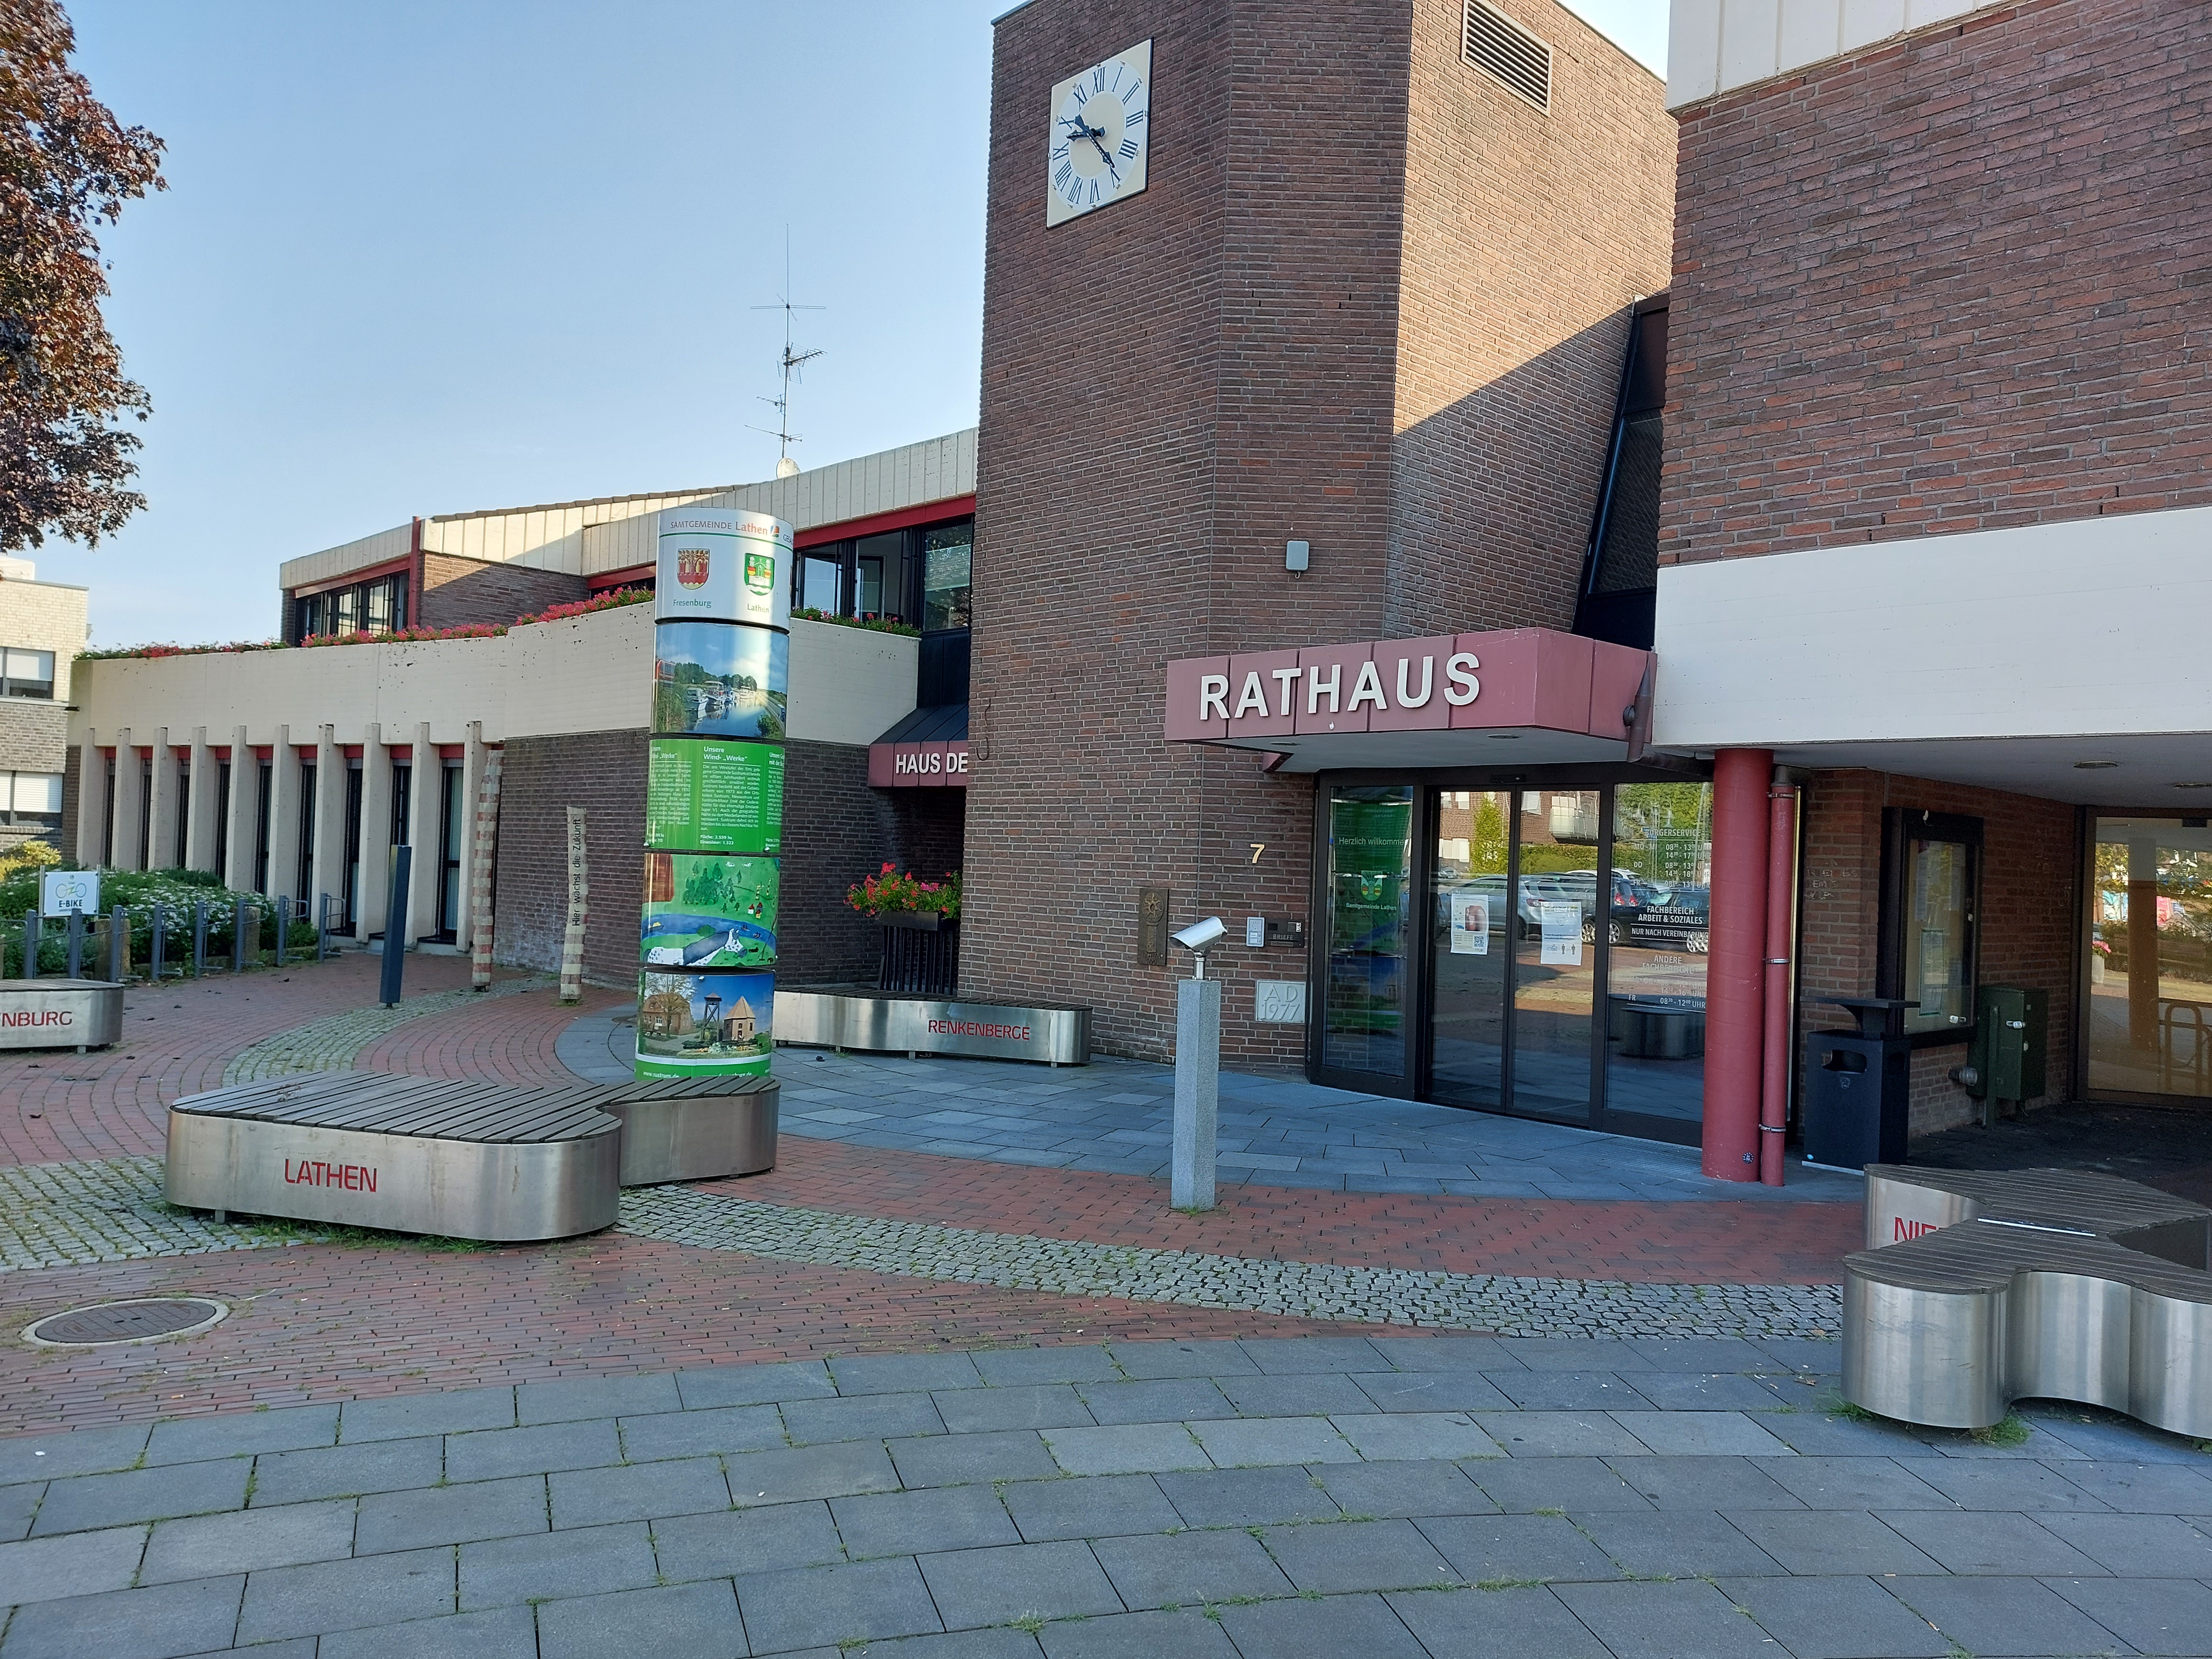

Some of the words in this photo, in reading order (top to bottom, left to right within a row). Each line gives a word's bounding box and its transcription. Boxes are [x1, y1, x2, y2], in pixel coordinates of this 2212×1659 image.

[671, 520, 732, 530] SAMTGEMEINDE
[735, 521, 767, 535] Lathen
[673, 599, 712, 608] Fresenburg
[747, 603, 769, 614] Lathen
[1200, 652, 1480, 720] RATHAUS
[896, 753, 940, 774] HAUS
[573, 818, 581, 851] Zukunft
[1339, 837, 1366, 845] Herzlich
[1250, 843, 1265, 864] 7
[572, 856, 581, 868] die
[572, 873, 580, 904] wächst
[59, 899, 83, 907] E-BIKE
[1647, 906, 1694, 915] FACHBEREICH
[572, 909, 580, 926] Hier
[1638, 914, 1661, 922] ARBEIT
[1670, 916, 1703, 924] SOZIALES
[1654, 955, 1682, 964] ANDERE
[0, 1011, 72, 1027] NBURG
[1261, 1002, 1300, 1020] 1977
[928, 1019, 1030, 1040] RENKENBERGE
[285, 1158, 377, 1193] LATHEN
